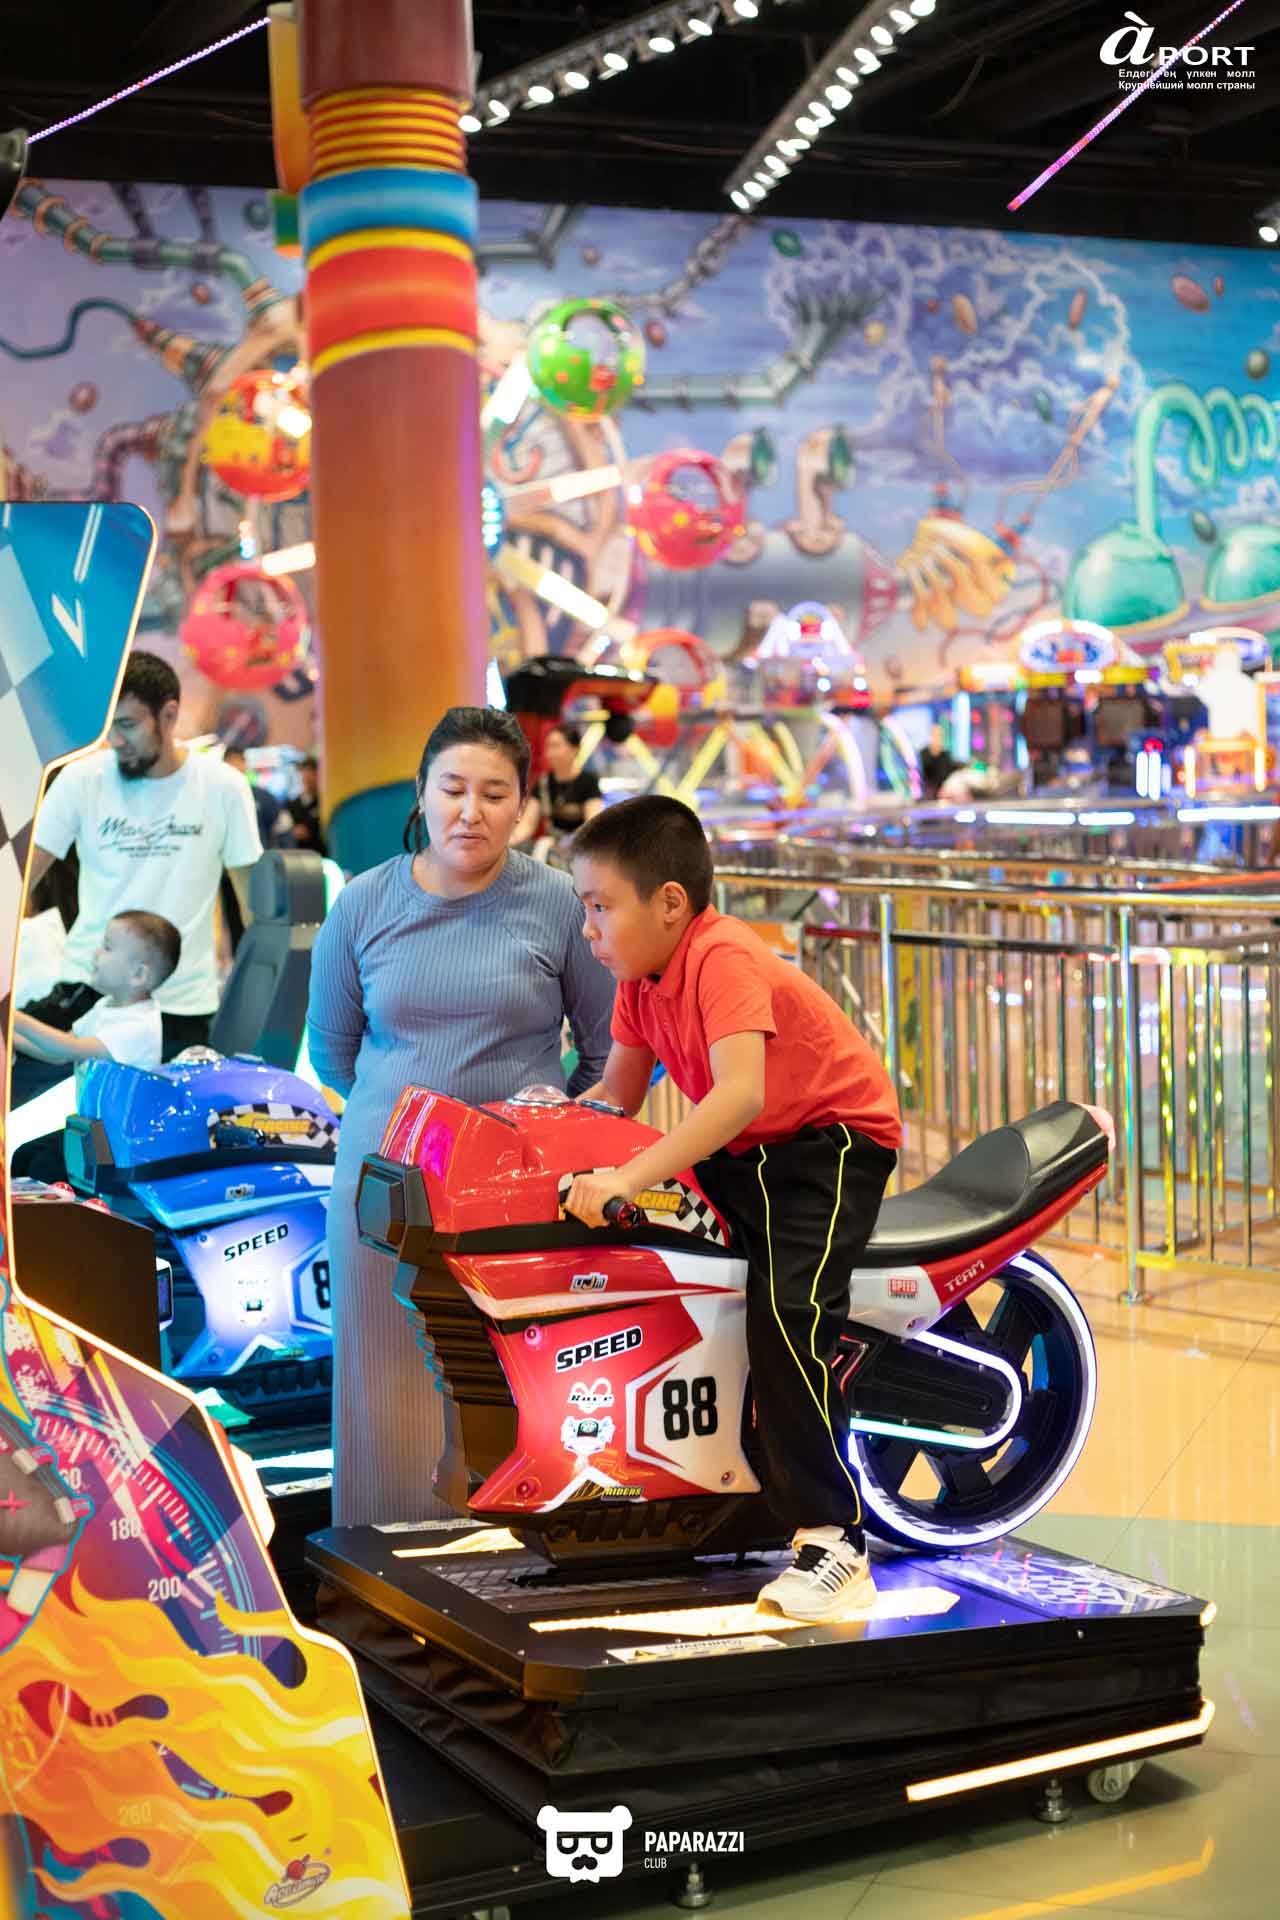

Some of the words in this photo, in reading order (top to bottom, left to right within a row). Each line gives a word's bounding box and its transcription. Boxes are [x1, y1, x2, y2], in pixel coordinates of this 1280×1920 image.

[223, 1224, 289, 1262] SPEED
[943, 1259, 985, 1292] TEAM
[556, 1327, 643, 1371] SPEED
[662, 1376, 718, 1441] 88
[109, 1518, 142, 1541] 180
[147, 1576, 182, 1602] 200
